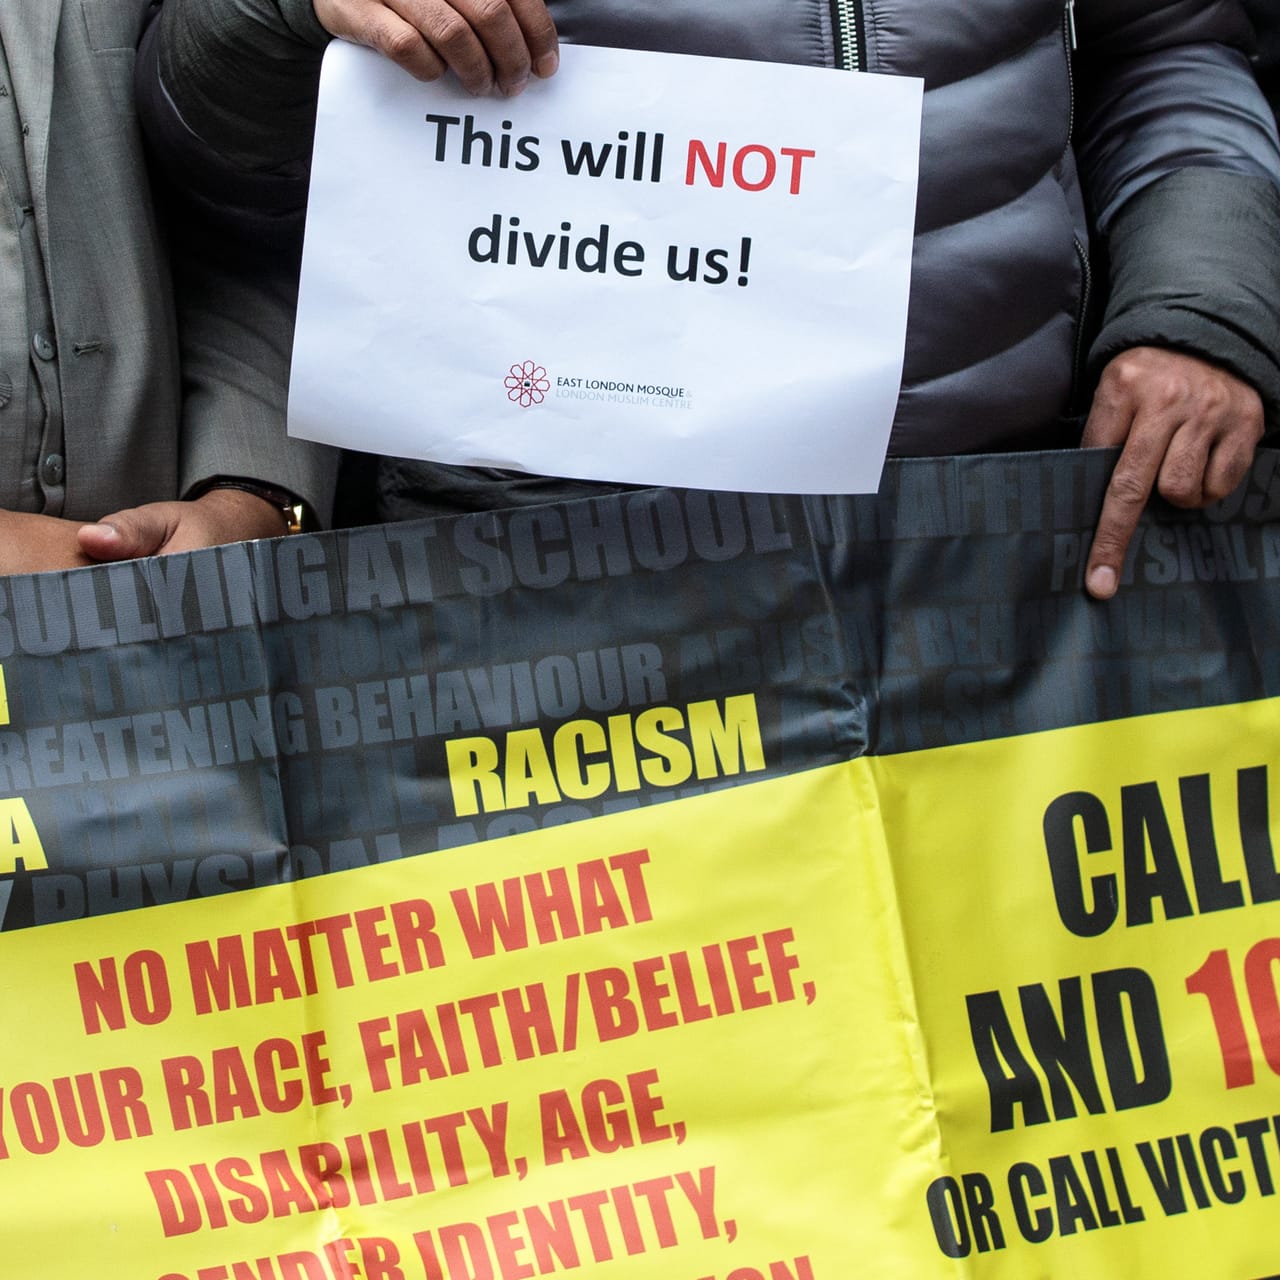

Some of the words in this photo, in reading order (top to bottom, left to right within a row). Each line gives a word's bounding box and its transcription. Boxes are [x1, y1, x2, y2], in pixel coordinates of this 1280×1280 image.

[426, 114, 540, 172] This
[561, 131, 664, 183] will
[685, 139, 816, 195] NOT
[468, 214, 646, 277] divide
[666, 237, 753, 287] us!
[555, 389, 604, 402] LONDON
[607, 394, 649, 406] MUSLIM
[652, 398, 693, 410] CENTRE
[557, 377, 582, 388] EAST
[585, 379, 634, 393] LONDON
[637, 384, 685, 399] MOSQUE
[345, 526, 437, 615] AT
[453, 488, 792, 598] SCHOOL
[316, 641, 668, 751] BEHAVIOUR
[445, 692, 766, 817] RACISM
[74, 950, 173, 1035] NO
[187, 898, 447, 1013] MATTER
[452, 848, 653, 957] WHAT
[160, 1030, 352, 1132] RACE,
[358, 927, 817, 1091] FAITH/BELIEF,
[964, 966, 1173, 1132] AND
[145, 1103, 529, 1238] DISABILITY,
[542, 1069, 688, 1166] AGE,
[925, 1175, 1007, 1260] OR
[1007, 1147, 1146, 1245] CALL
[412, 1166, 738, 1280] IDENTITY,
